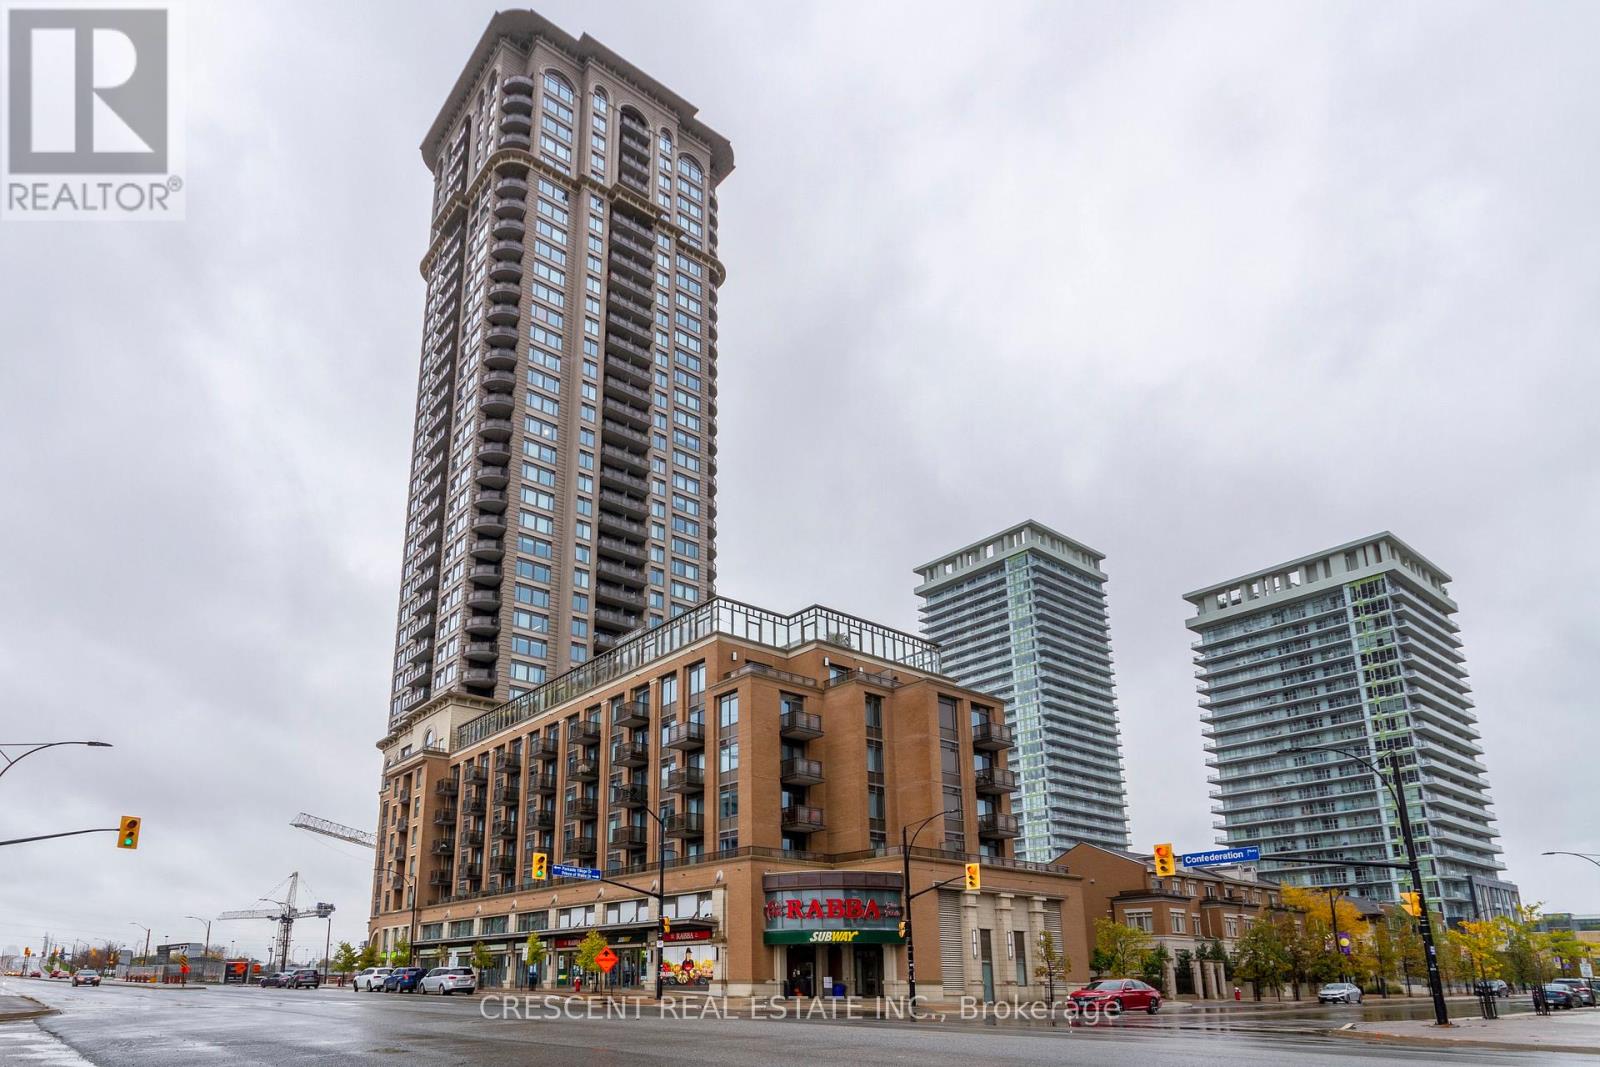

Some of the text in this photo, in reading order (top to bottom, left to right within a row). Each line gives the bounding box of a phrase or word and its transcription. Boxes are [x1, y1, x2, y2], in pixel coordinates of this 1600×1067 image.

[1185, 851, 1244, 864] Confederation
[785, 897, 881, 921] RABBA
[810, 931, 859, 943] SUBWAY
